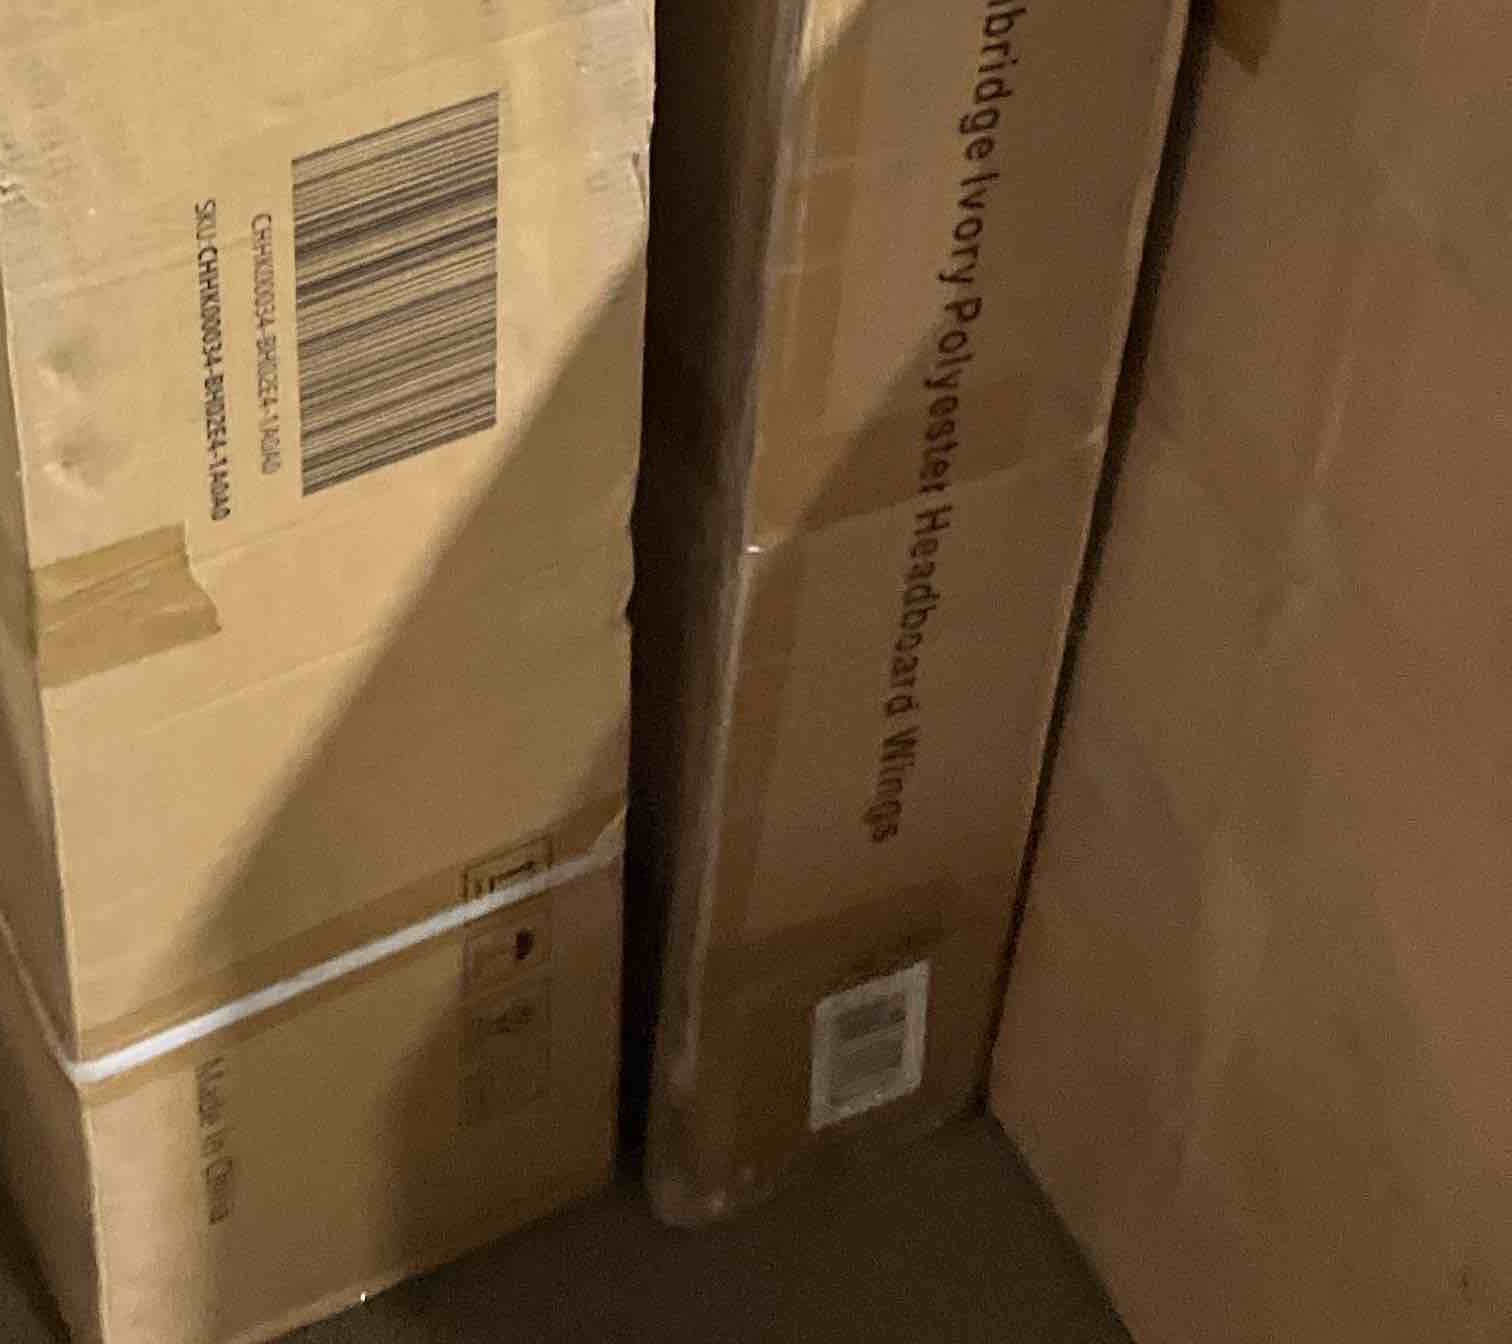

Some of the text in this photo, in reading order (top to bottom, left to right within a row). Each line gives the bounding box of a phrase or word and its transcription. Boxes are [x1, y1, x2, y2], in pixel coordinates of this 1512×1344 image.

[936, 171, 1002, 288] Ivory
[918, 293, 984, 496] Polyester
[882, 505, 953, 718] Headboard
[862, 726, 921, 846] Wings
